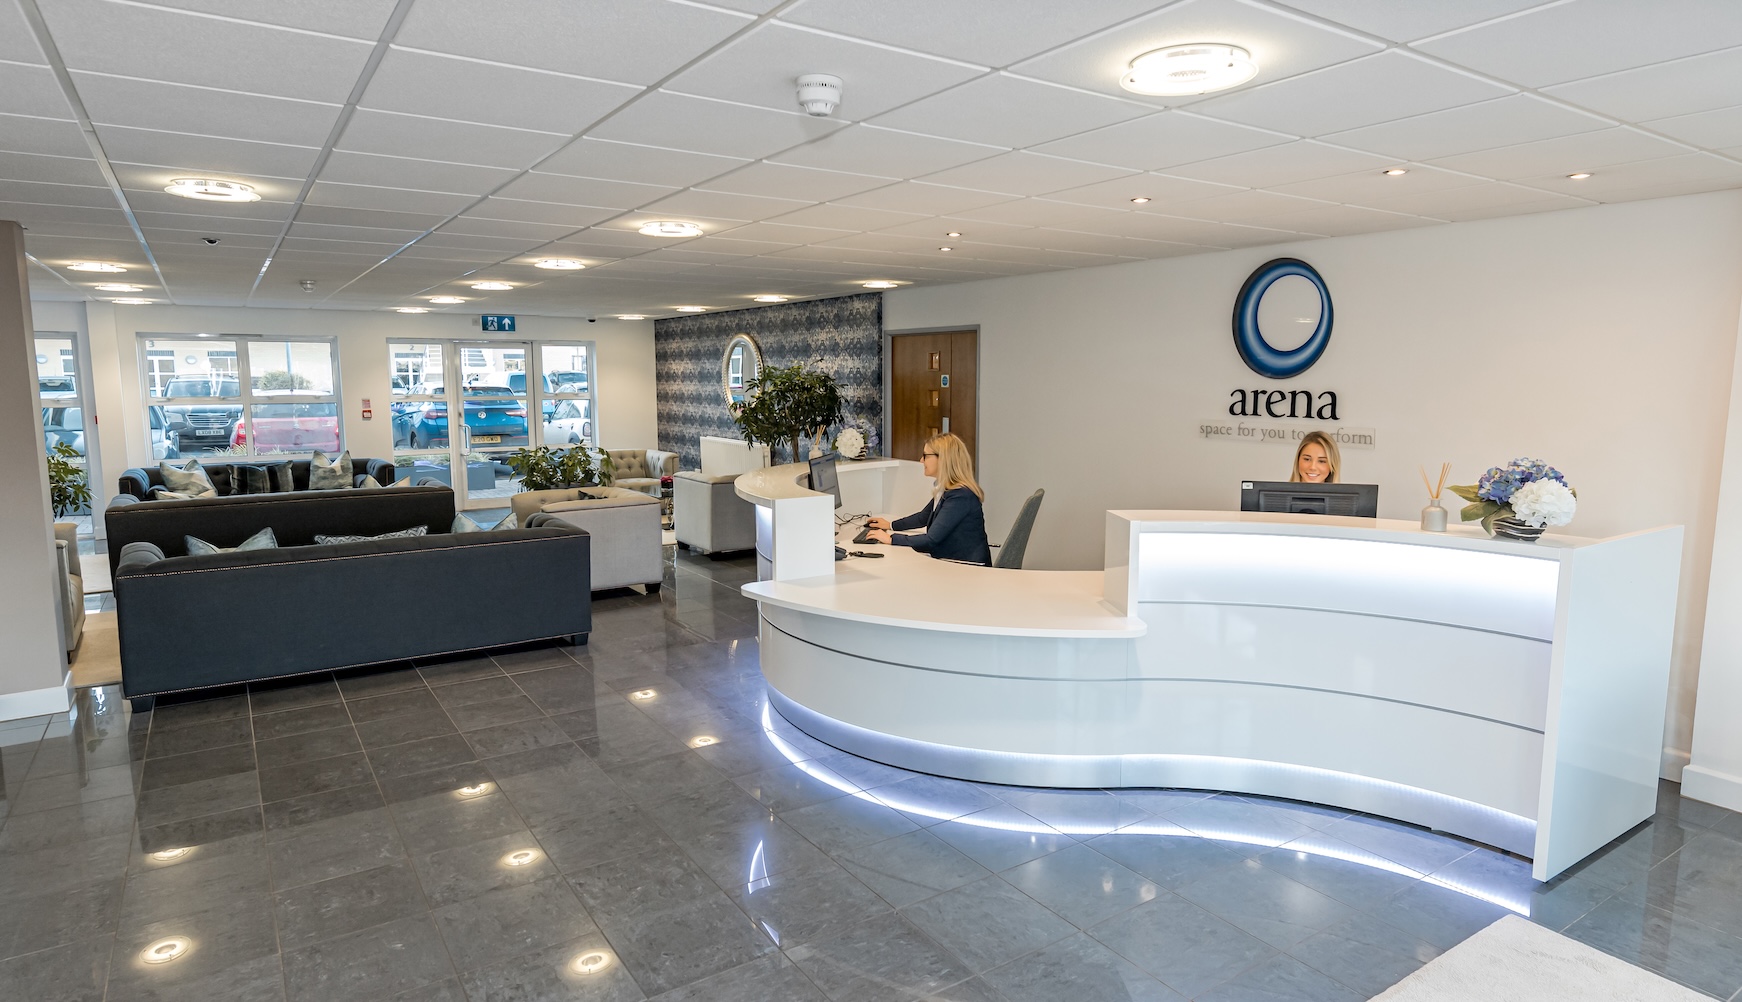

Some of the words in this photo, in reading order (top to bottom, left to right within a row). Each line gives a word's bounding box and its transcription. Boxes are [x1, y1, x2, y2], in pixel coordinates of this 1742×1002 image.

[1229, 388, 1340, 420] arena
[1199, 423, 1233, 438] space
[1237, 421, 1256, 437] for
[1260, 428, 1285, 441] you
[1291, 428, 1306, 441] to
